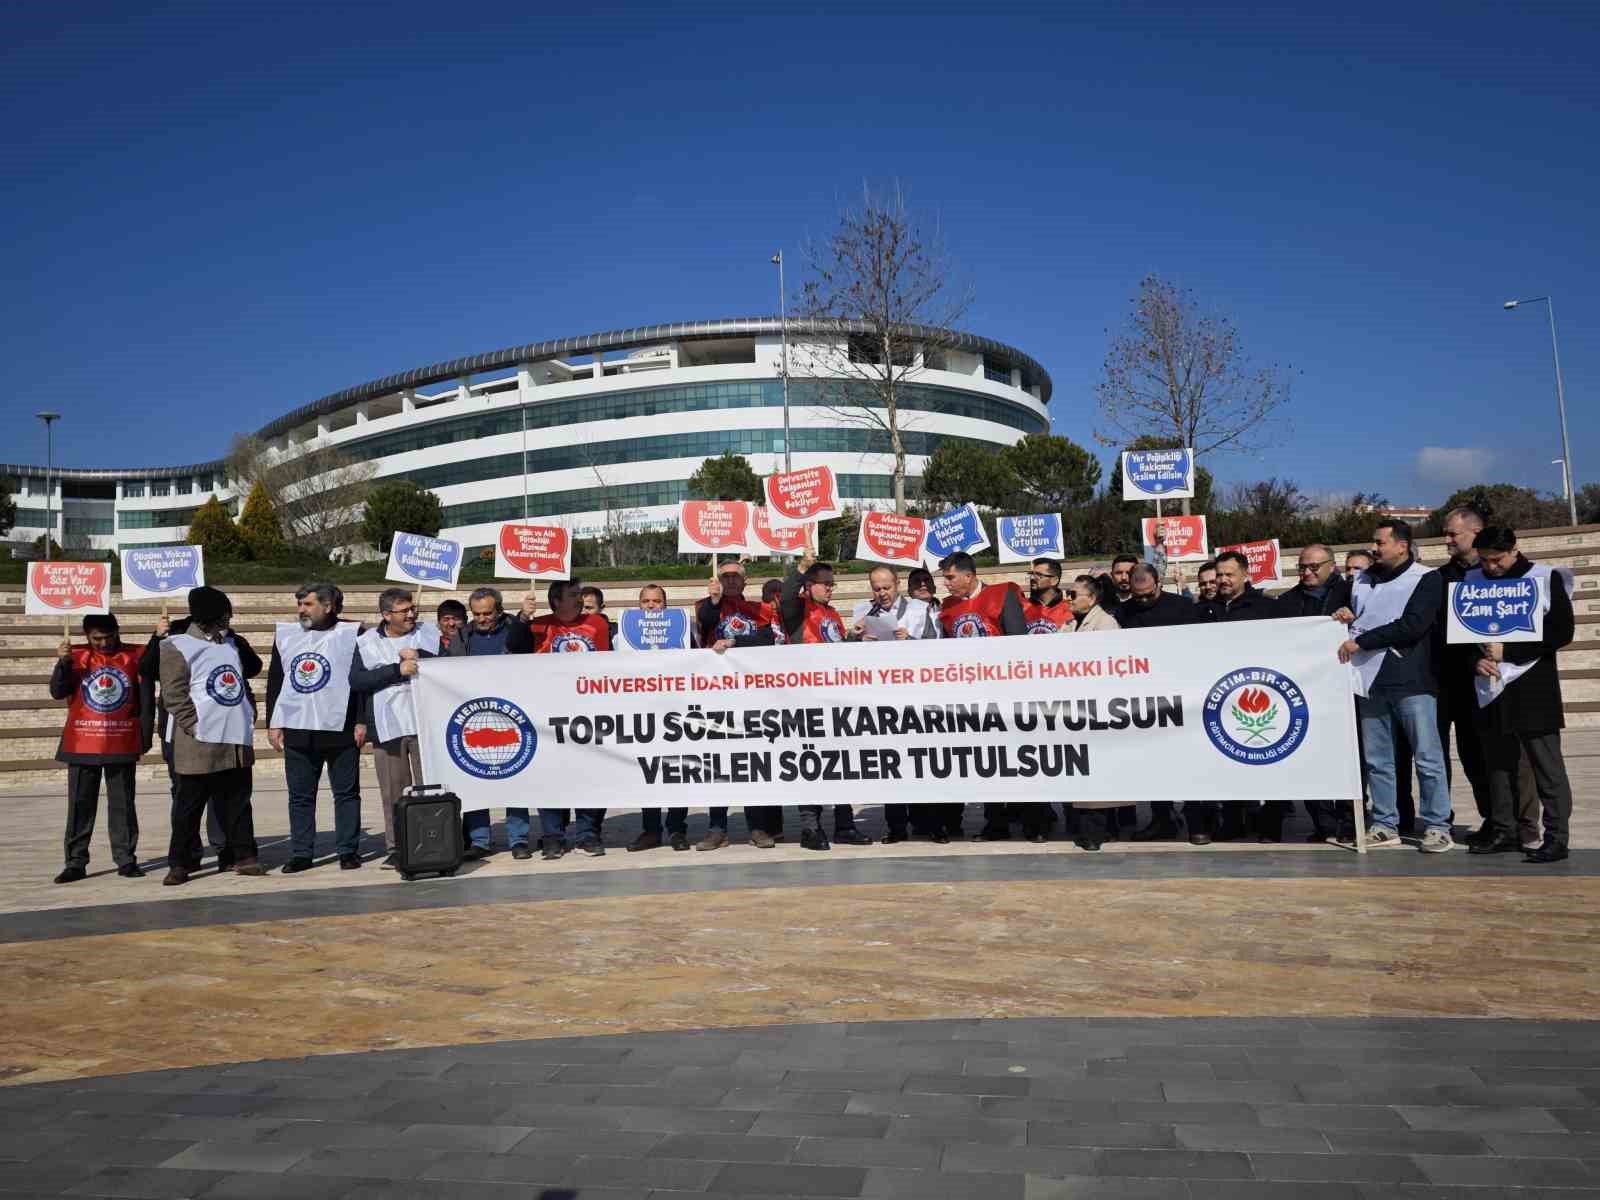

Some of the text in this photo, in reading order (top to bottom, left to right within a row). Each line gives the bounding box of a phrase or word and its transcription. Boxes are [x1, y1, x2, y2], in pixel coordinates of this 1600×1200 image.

[1012, 517, 1045, 528] Verilen
[1014, 527, 1044, 537] Sözler
[1010, 537, 1050, 547] Tutulsun
[43, 564, 96, 576] Karar Var
[154, 570, 173, 578] Var
[49, 575, 89, 585] Söz Var
[74, 584, 96, 595] YOK
[1460, 582, 1531, 600] Akademik
[1461, 600, 1529, 619] Zam Şart
[576, 655, 1150, 694] ÜNİVERSİTE İDARİ PERSONELİNİN YER DEĞİŞİKLİĞİ HAKKI İÇİN
[549, 695, 1184, 745] TOPLU SÖZLEŞME KARARINA UYULSUN
[637, 744, 1090, 784] VERİLEN SÖZLER TUTULSUN
